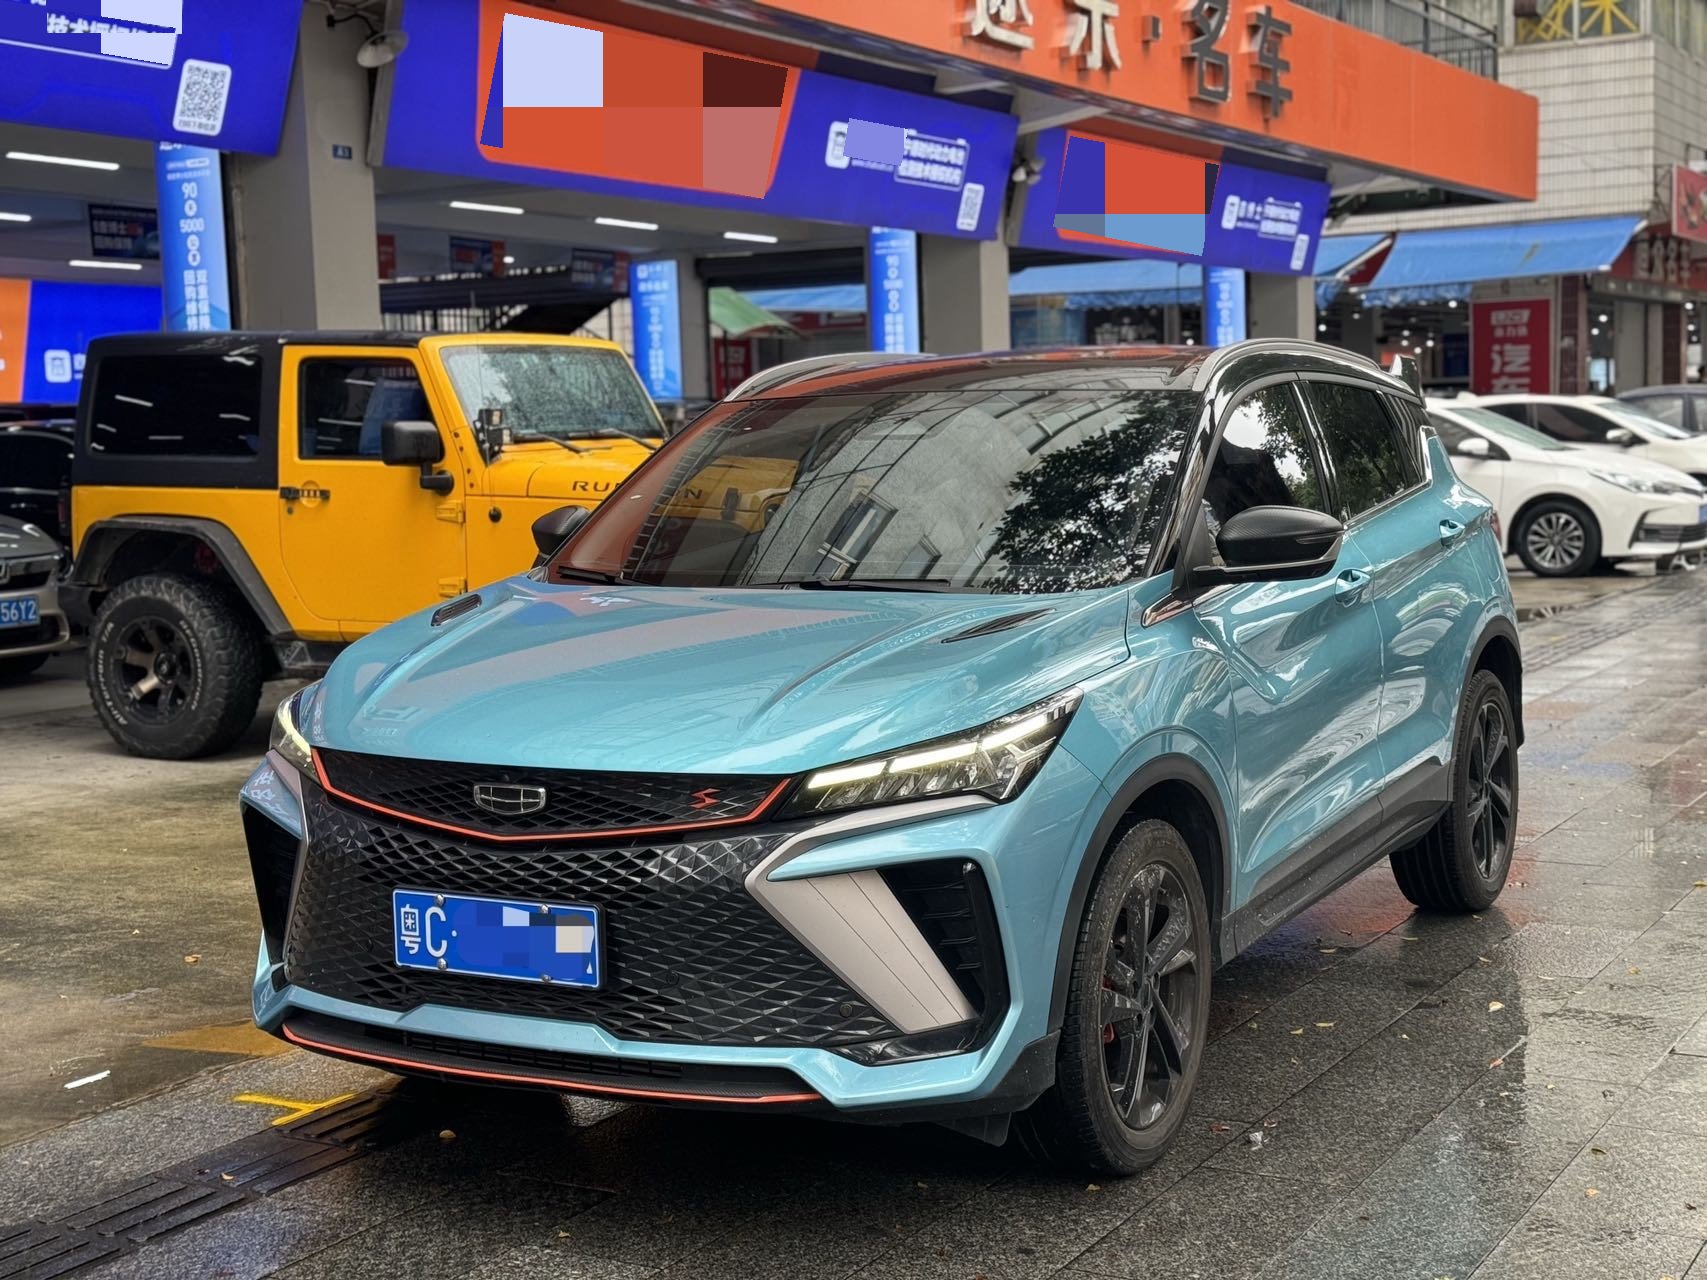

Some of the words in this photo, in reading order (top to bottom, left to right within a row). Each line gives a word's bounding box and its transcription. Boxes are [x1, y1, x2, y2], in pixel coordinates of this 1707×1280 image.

[182, 183, 198, 199] 90
[180, 218, 205, 233] 5000
[0, 600, 37, 622] 56Y2
